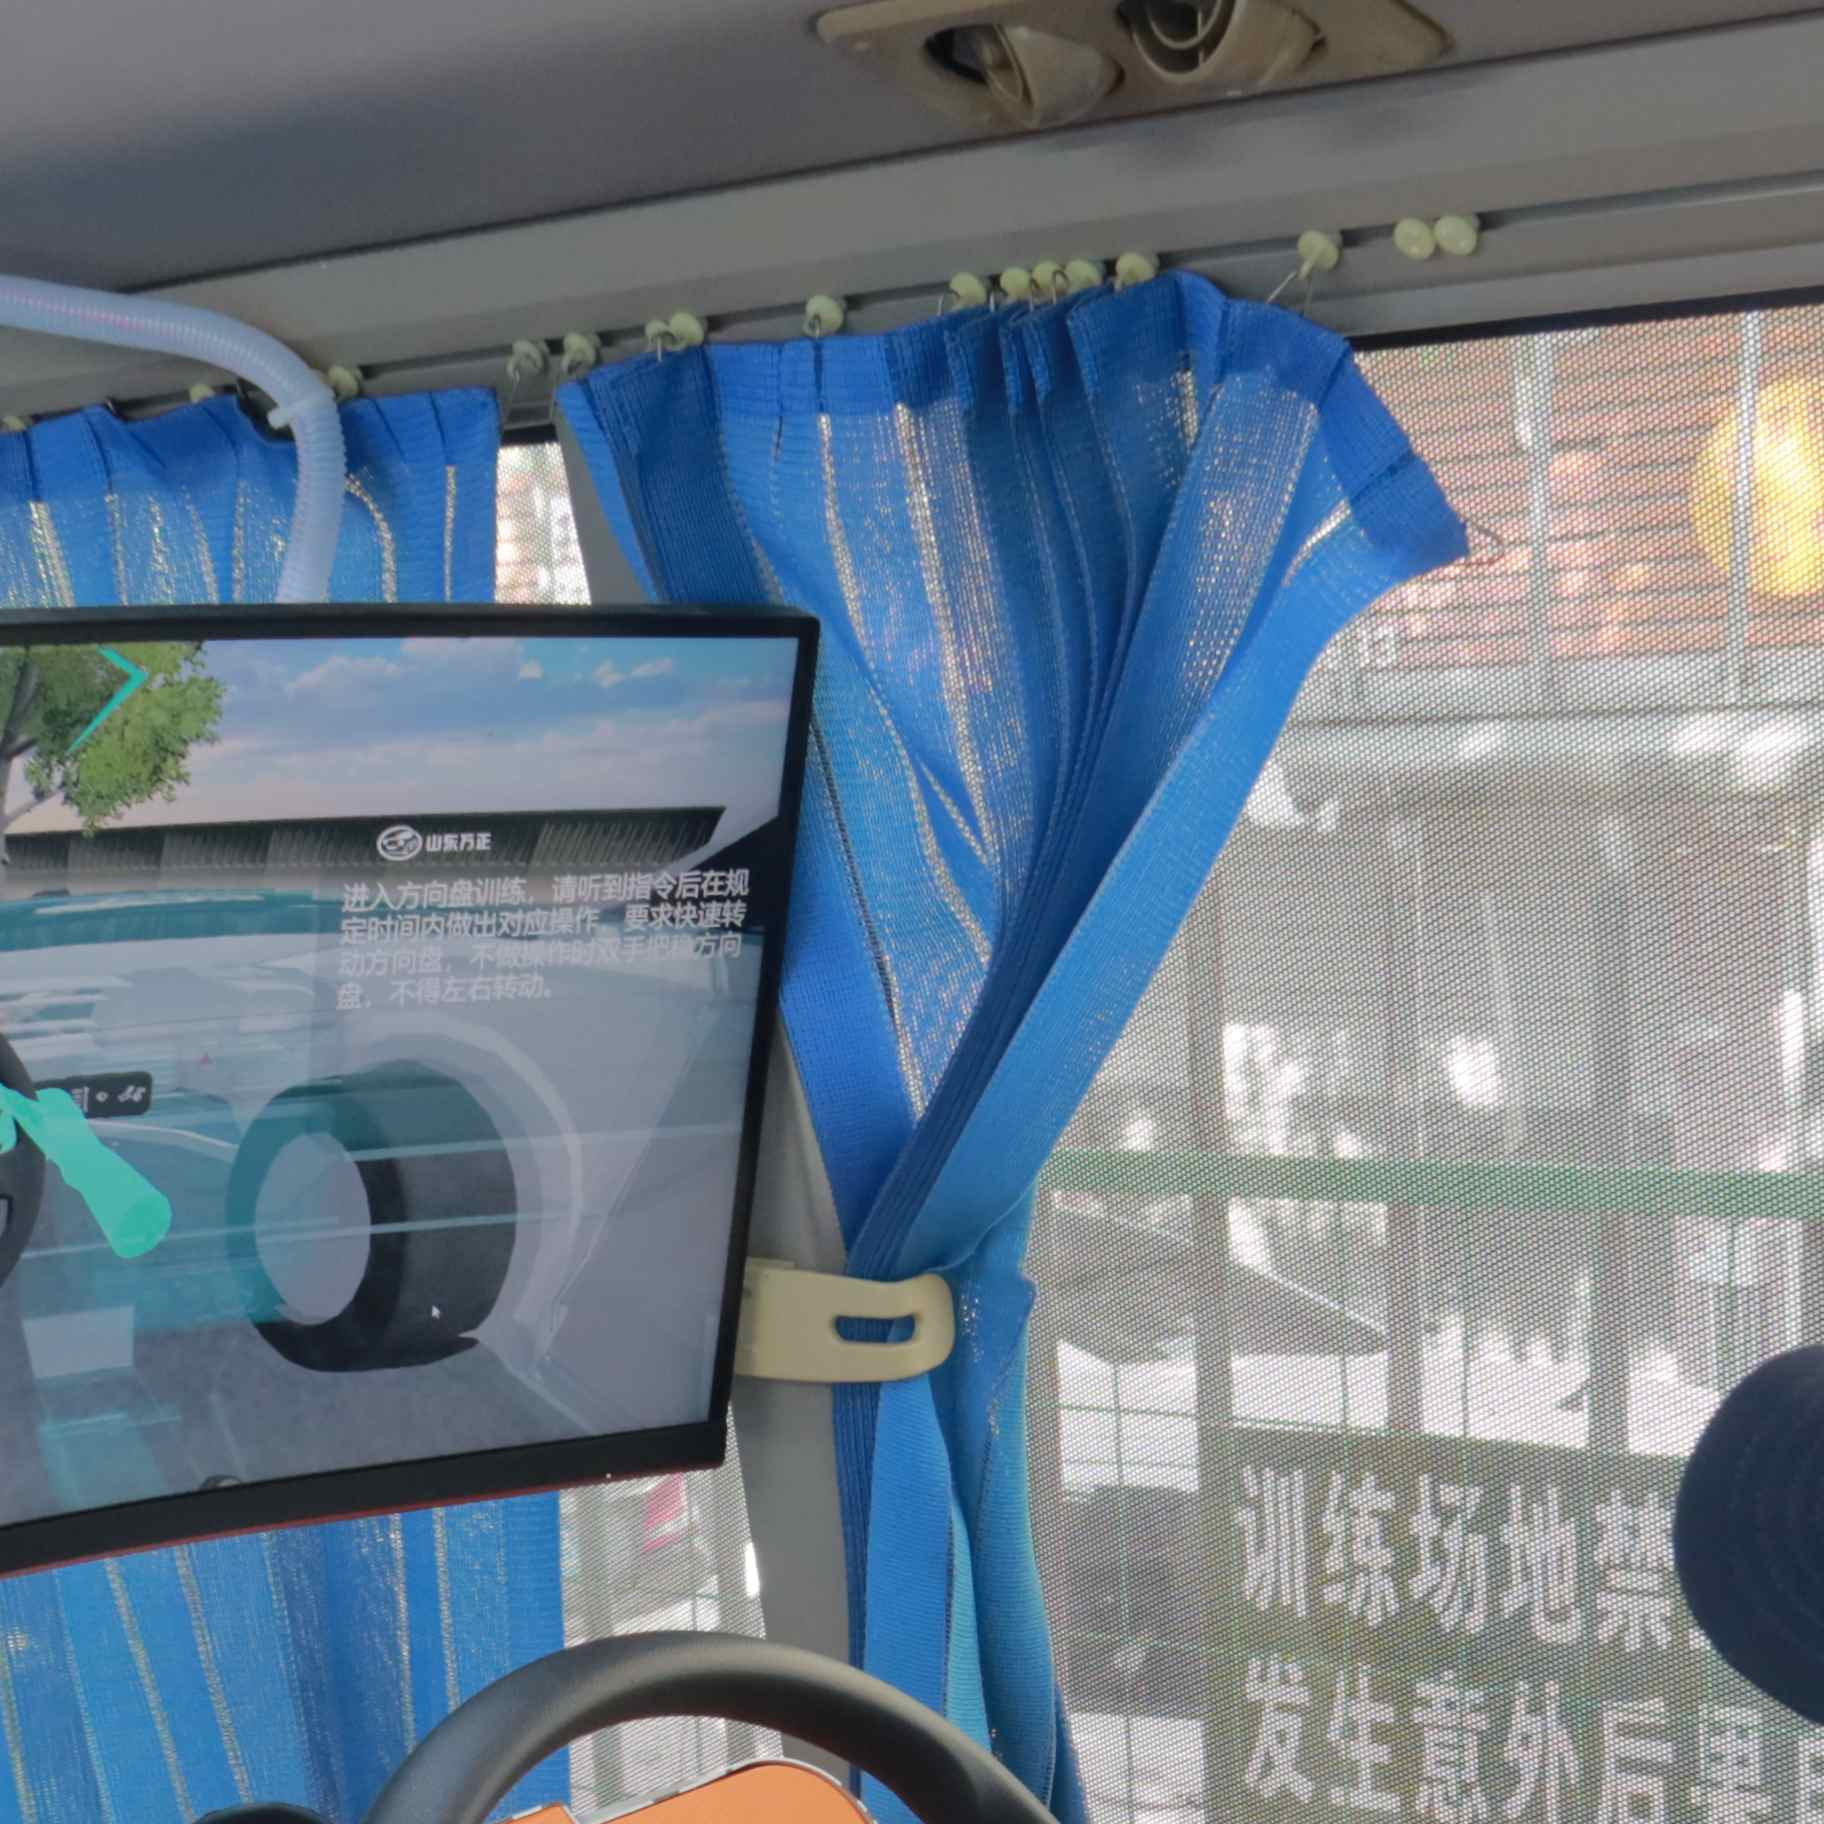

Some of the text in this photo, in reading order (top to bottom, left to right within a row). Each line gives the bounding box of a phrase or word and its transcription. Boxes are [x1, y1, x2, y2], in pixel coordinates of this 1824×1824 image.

[341, 900, 748, 945] 定时间内做出对应操作要求快速转
[1236, 1463, 1706, 1652] 训练场地禁
